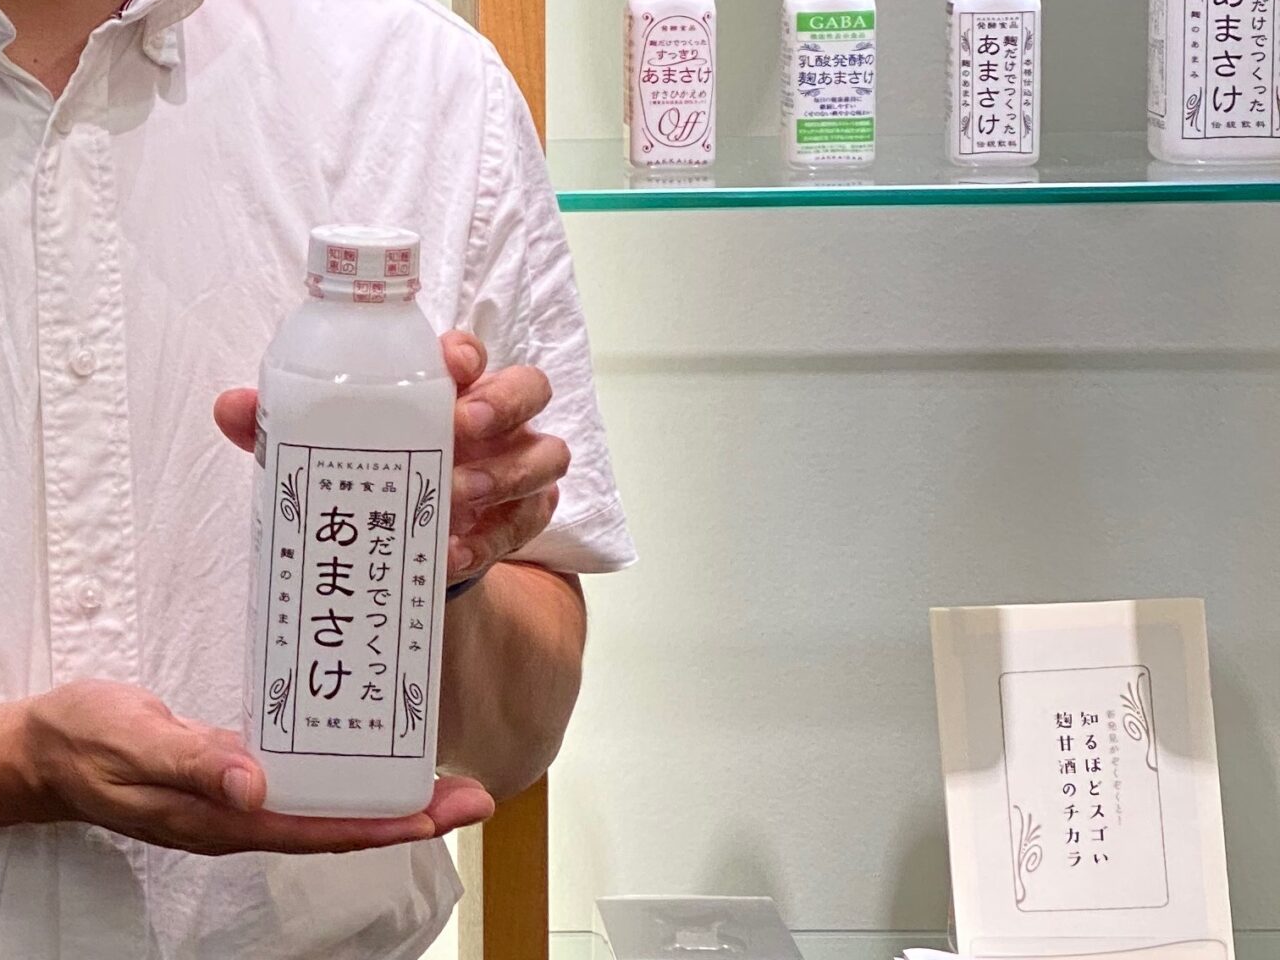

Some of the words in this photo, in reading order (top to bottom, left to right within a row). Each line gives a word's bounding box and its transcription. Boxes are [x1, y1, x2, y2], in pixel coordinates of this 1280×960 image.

[809, 15, 867, 29] GABA
[977, 21, 1019, 29] 発酵食品
[649, 39, 707, 47] 麹だけでつくった
[656, 49, 698, 60] すっきり
[1190, 10, 1201, 79] 麹のあまみ
[798, 54, 875, 68] 乳酸発酵の
[642, 67, 712, 84] あまさけ
[798, 70, 874, 86] 麹あまさけ
[962, 59, 970, 107] 麹のあまみ
[977, 34, 1000, 135] あまさけ
[1003, 35, 1018, 135] 麹だけでつくった
[651, 90, 707, 100] 甘さひかえめ
[658, 106, 706, 142] Off
[317, 460, 402, 471] HAKKAISAN
[319, 478, 397, 493] 発酵食品
[275, 547, 295, 647] 麹のあまみ
[309, 505, 358, 700] あまさけ
[360, 511, 397, 701] 麹だけでつくった
[408, 553, 427, 652] 本格仕込み
[305, 716, 384, 730] 伝統飲料
[1054, 712, 1082, 868] 麹甘酒のチカラ
[1080, 711, 1109, 864] 知るほどスゴい
